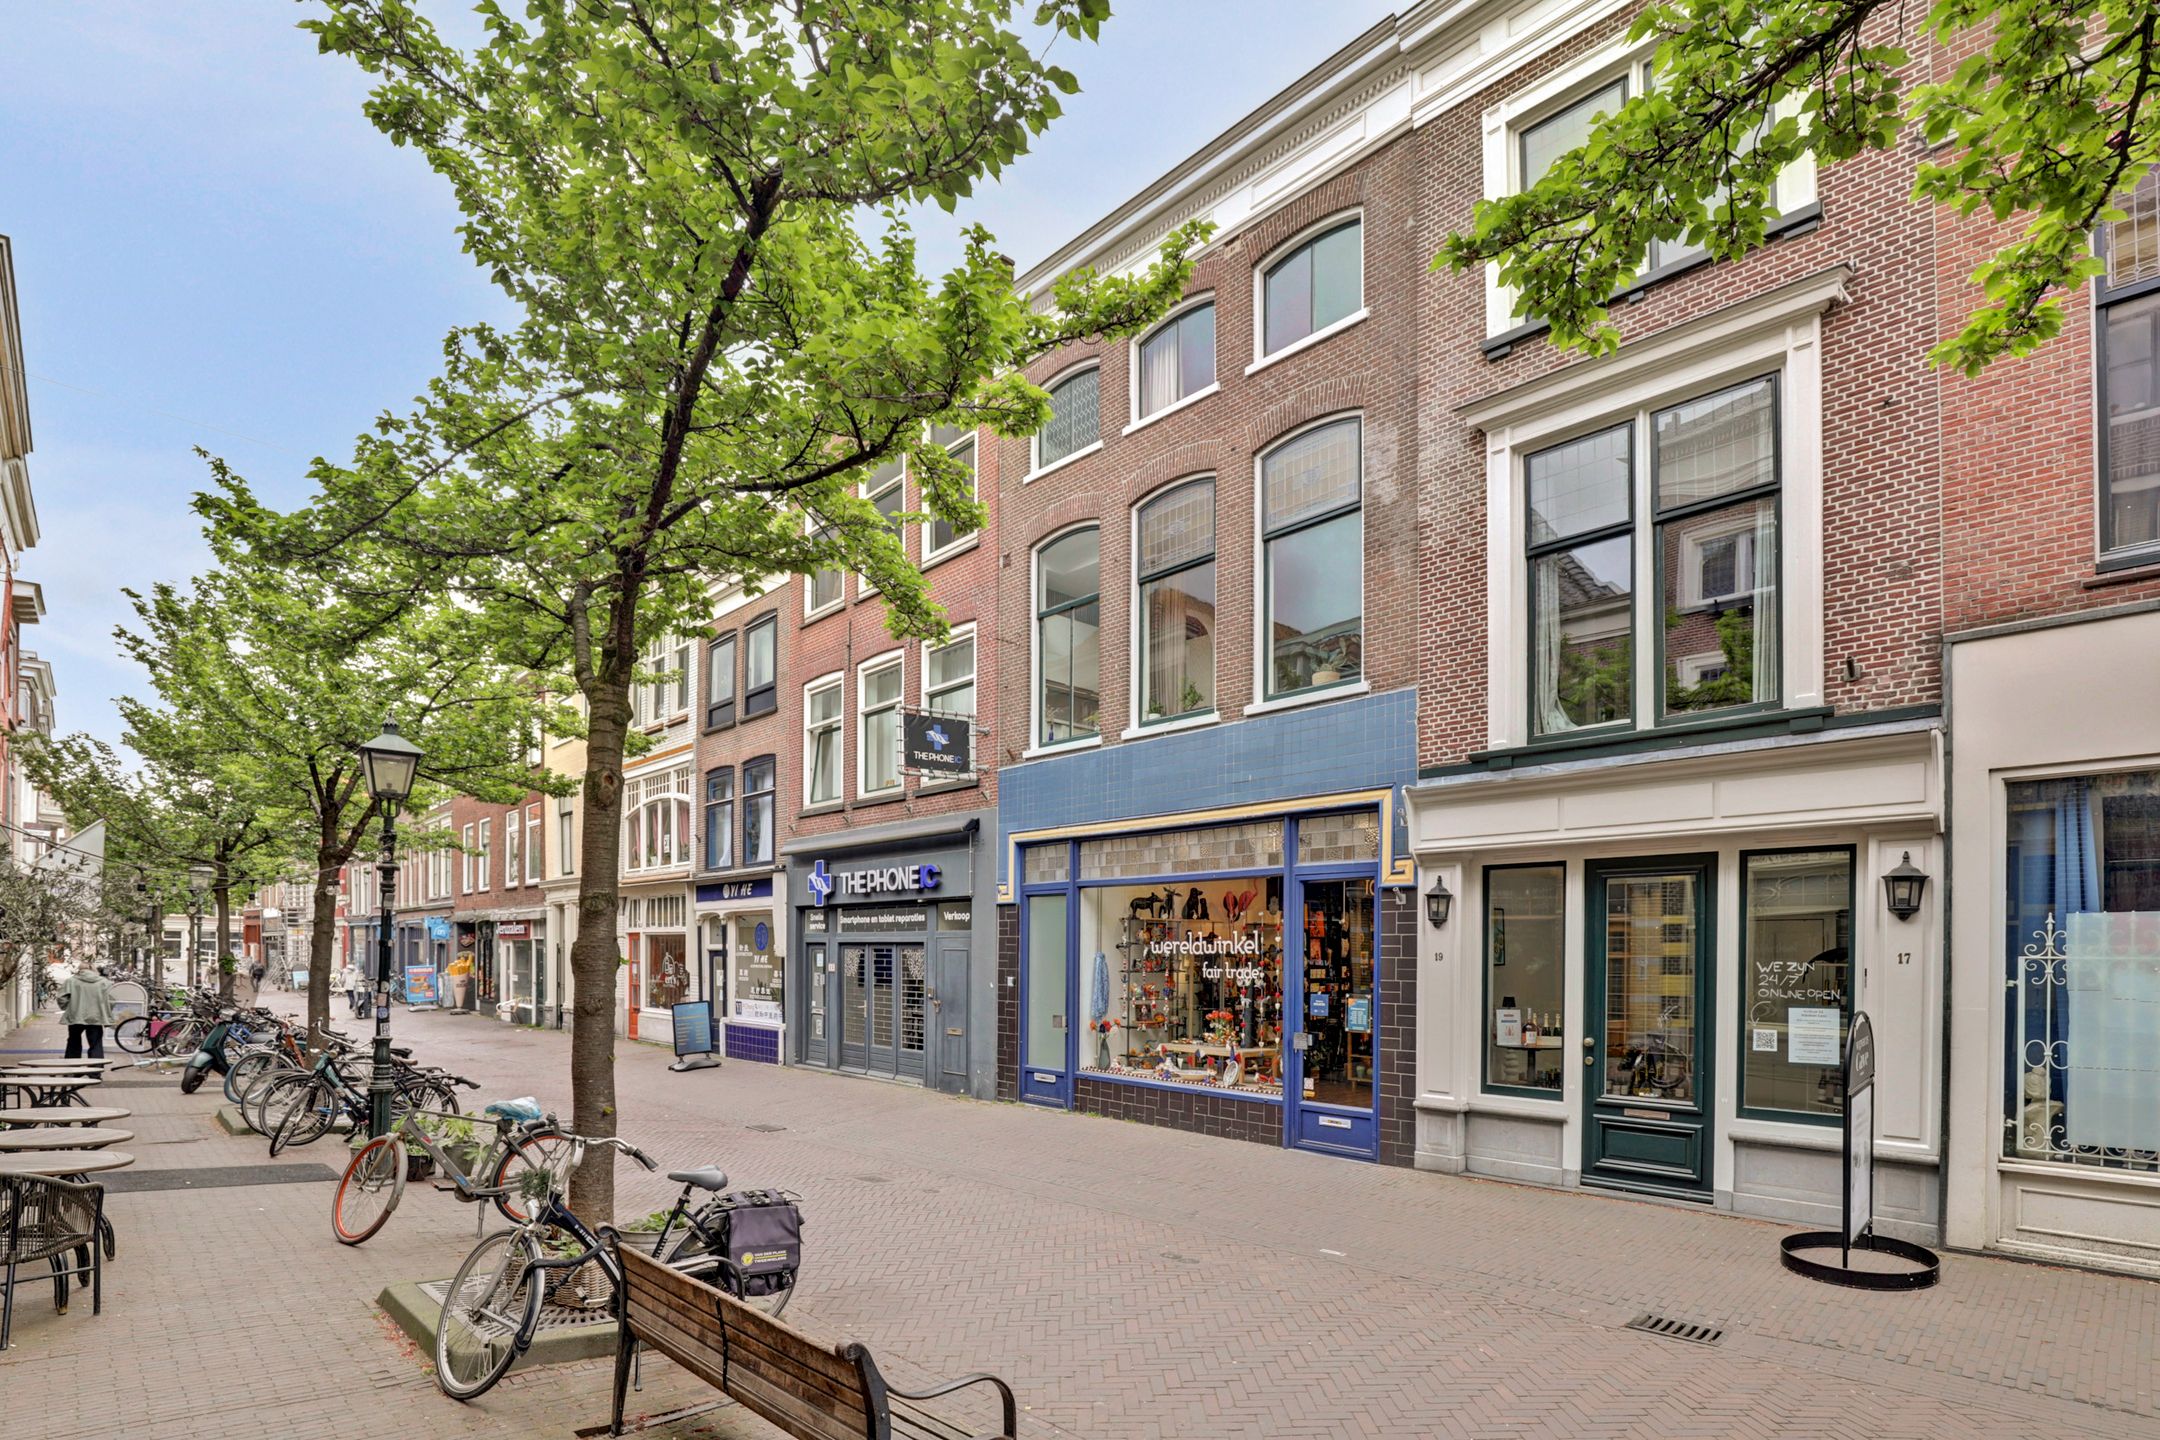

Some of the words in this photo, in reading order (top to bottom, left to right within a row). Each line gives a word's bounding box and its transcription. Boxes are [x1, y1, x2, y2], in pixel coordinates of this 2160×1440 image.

[810, 913, 824, 921] Snelle
[840, 915, 870, 926] Smartphone
[879, 913, 895, 923] tablet
[895, 912, 926, 924] reparaties
[943, 911, 971, 922] Verkoop
[809, 922, 826, 930] service
[1150, 930, 1260, 955] wereldwinkel
[1434, 952, 1444, 962] 19
[1897, 952, 1912, 965] 17
[1202, 961, 1223, 979] fair
[1225, 962, 1260, 979] trade
[1756, 961, 1784, 973] WE
[1758, 974, 1800, 987] 24/7
[1757, 988, 1806, 1000] ONLINE
[1806, 988, 1841, 1002] OPEN
